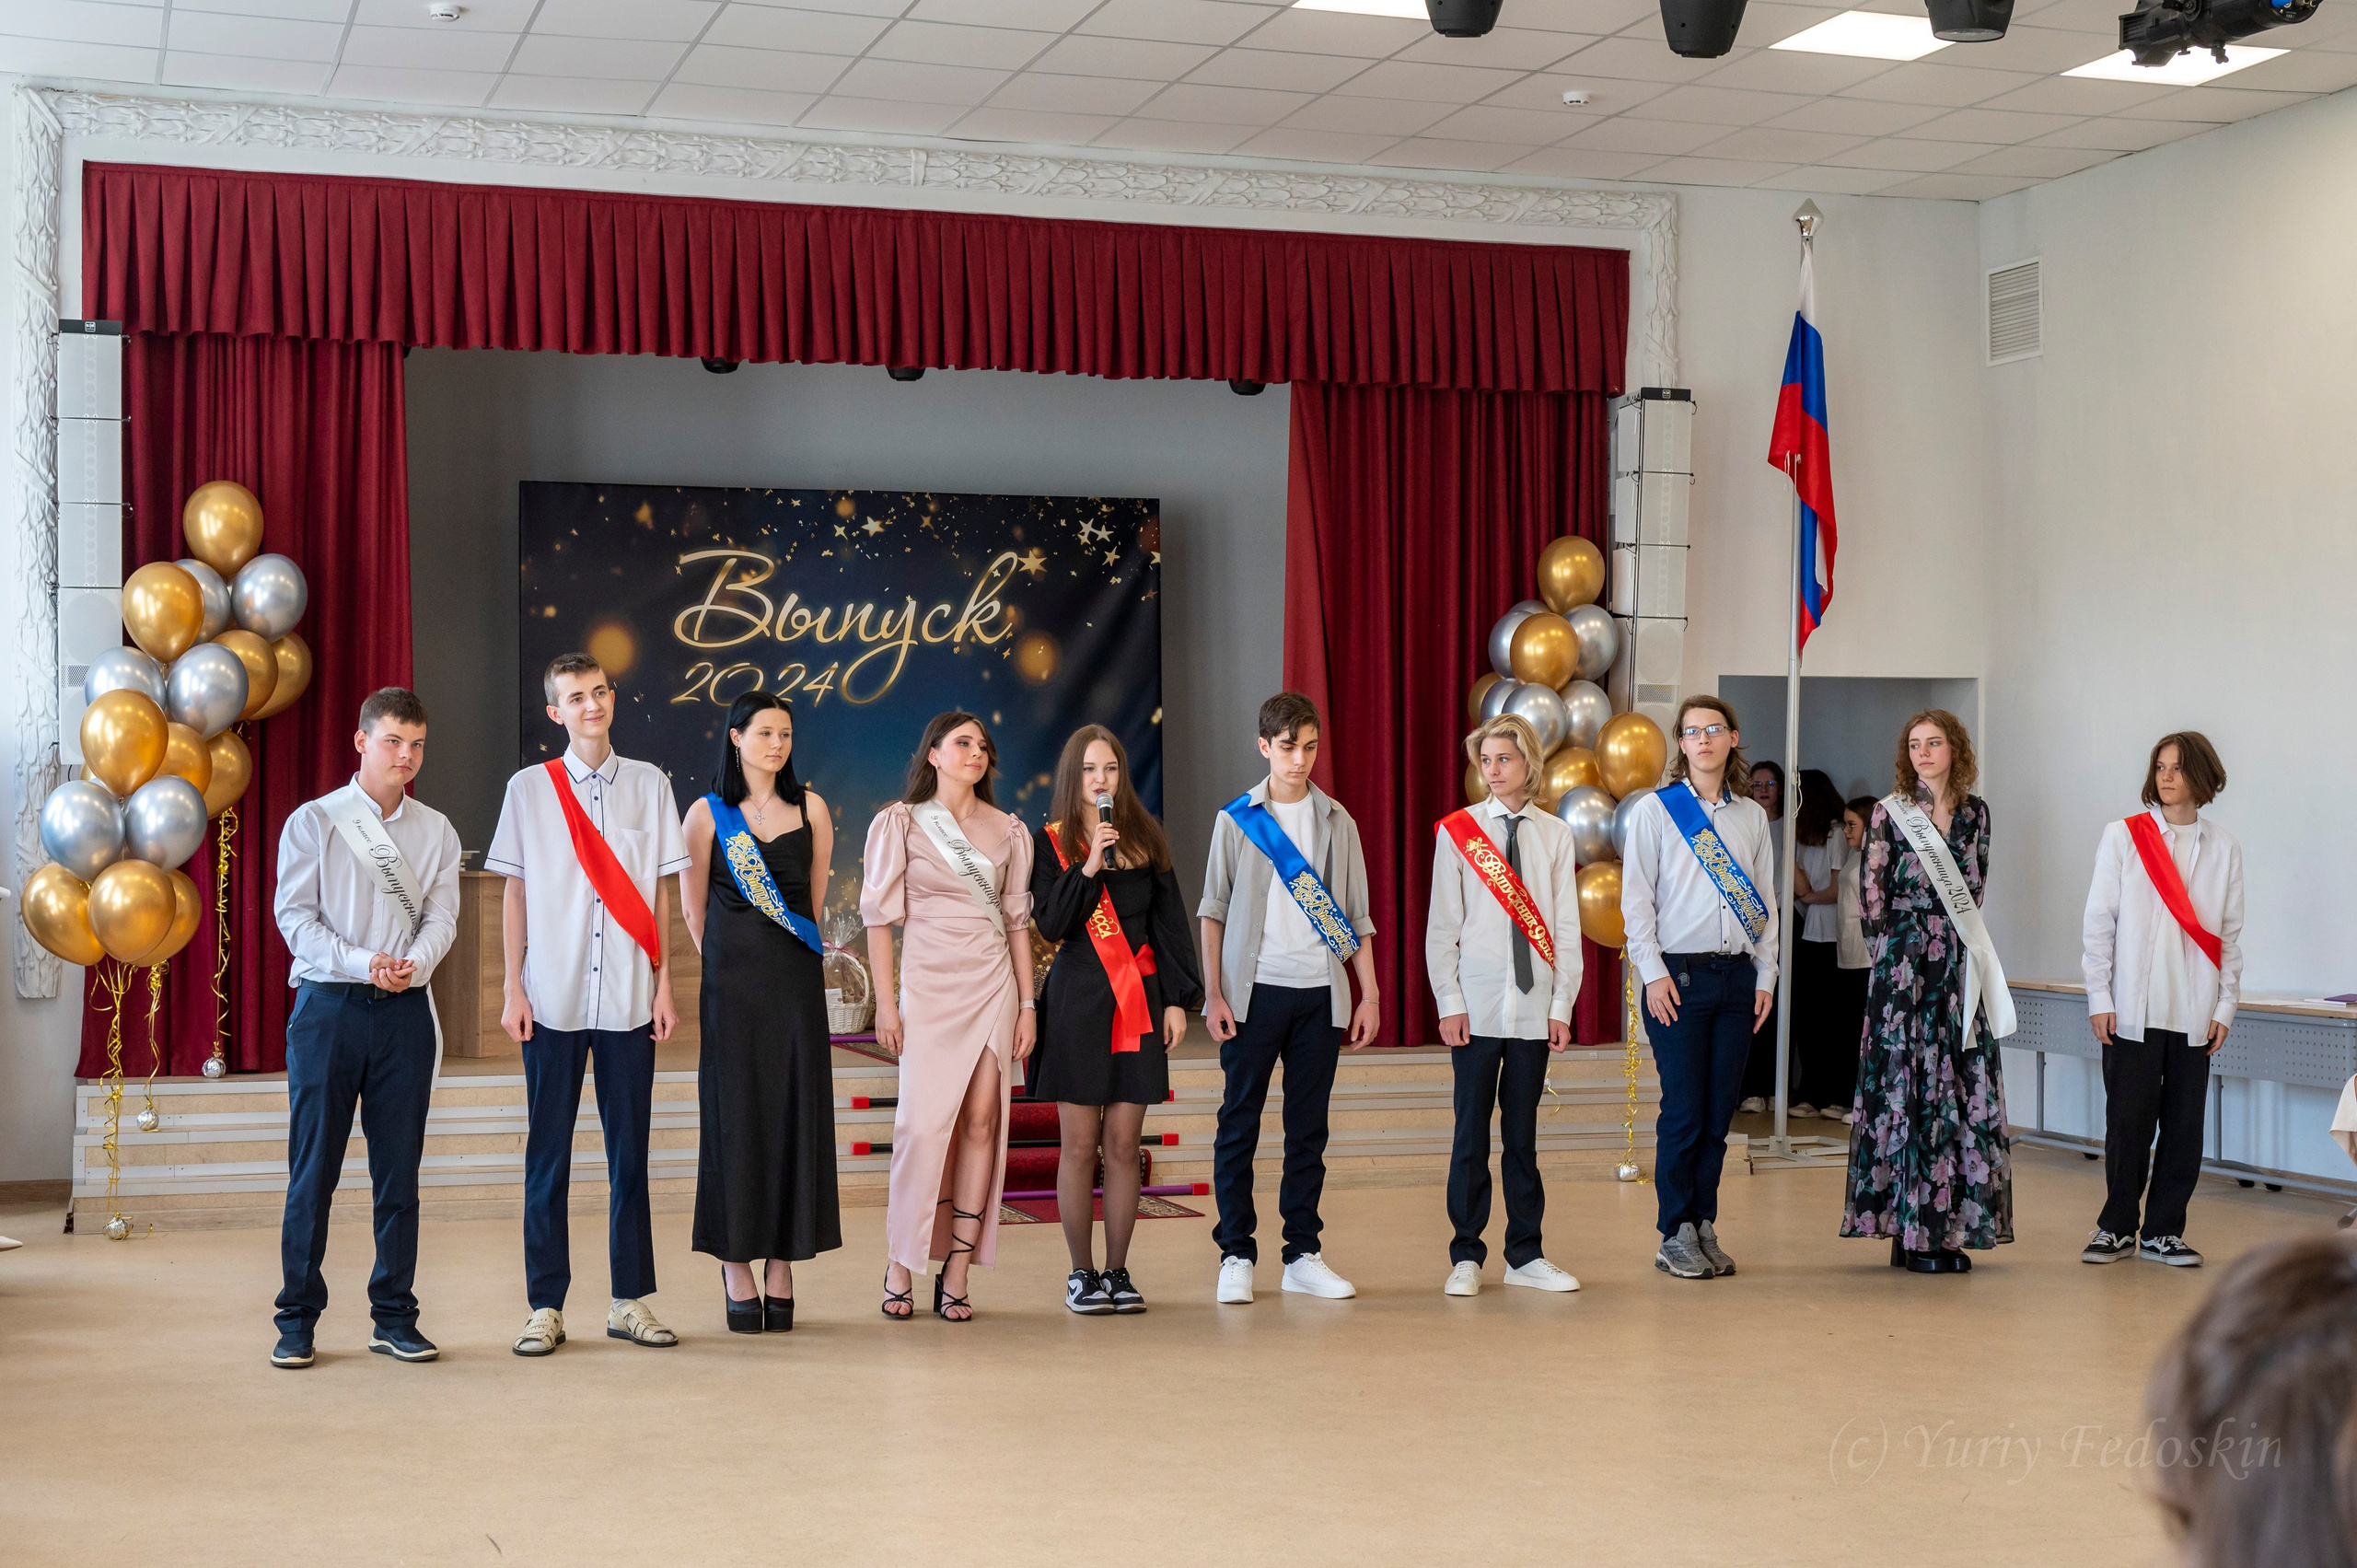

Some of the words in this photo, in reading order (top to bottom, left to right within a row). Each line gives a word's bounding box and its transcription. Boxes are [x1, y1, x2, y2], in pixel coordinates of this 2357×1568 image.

[674, 550, 1018, 704] Выпуск
[670, 661, 839, 707] 2024
[368, 843, 419, 923] Выпускни
[1906, 816, 1953, 889] Выпускница
[1947, 885, 1973, 914] 2024
[1092, 902, 1113, 939] АССА
[1527, 924, 1546, 940] 9
